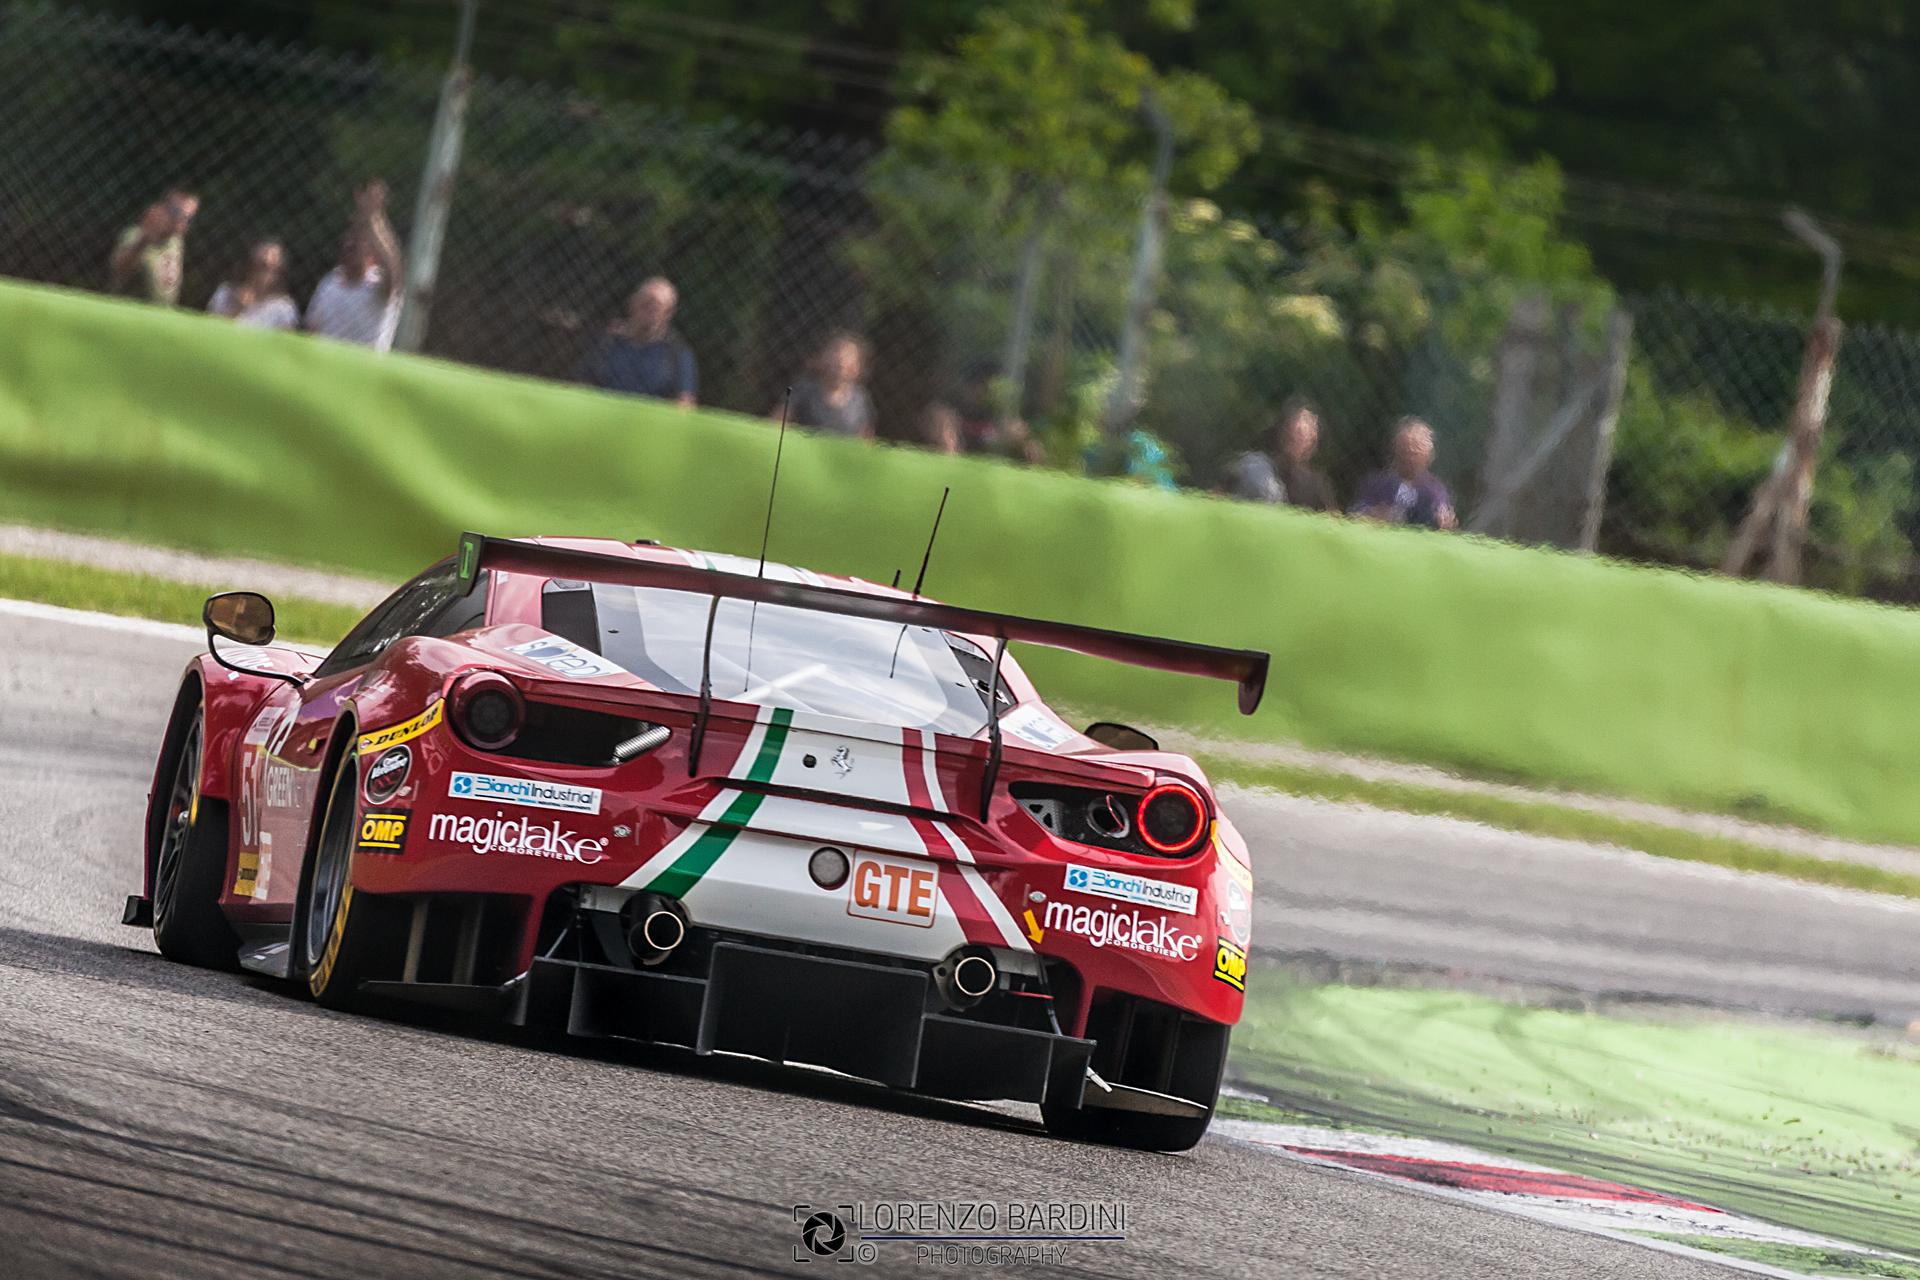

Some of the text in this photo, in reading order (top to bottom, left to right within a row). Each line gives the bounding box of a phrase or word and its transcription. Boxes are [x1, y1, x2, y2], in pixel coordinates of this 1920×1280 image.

[374, 706, 438, 746] DUNLOP
[476, 776, 594, 804] Bianchi Industrial
[361, 819, 405, 842] OMP
[428, 811, 603, 865] magiclake
[490, 844, 574, 862] COMOREVIEW
[854, 860, 934, 918] GTE
[1091, 871, 1142, 893] Bianchi
[1143, 880, 1192, 904] Industrial
[1044, 901, 1199, 962] magiclake
[1106, 938, 1178, 958] COMOREVIEW
[1216, 947, 1247, 982] OMP
